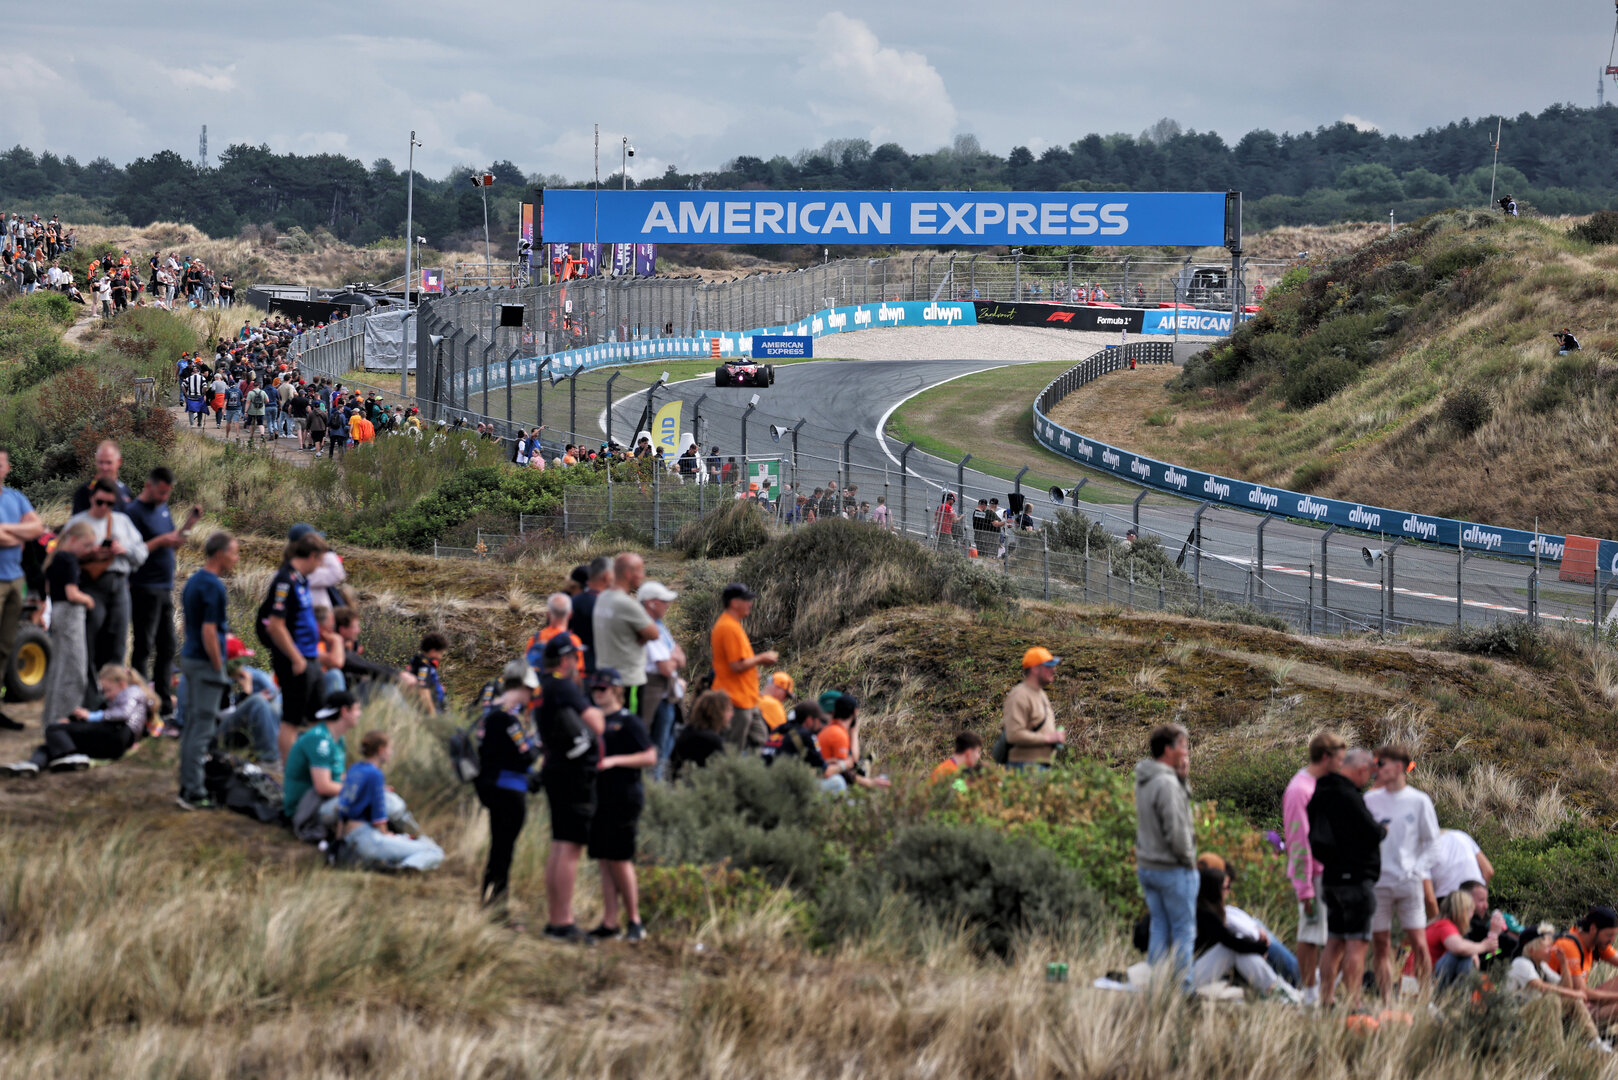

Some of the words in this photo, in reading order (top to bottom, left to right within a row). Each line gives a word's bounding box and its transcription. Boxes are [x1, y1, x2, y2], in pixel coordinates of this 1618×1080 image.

[641, 202, 891, 234] AMERICAN
[910, 203, 1129, 235] EXPRESS
[923, 302, 961, 326] allwyn
[1097, 316, 1123, 325] Formula
[1158, 315, 1231, 332] AMERICAN
[761, 341, 804, 349] AMERICAN
[767, 348, 805, 356] EXPRESS
[661, 417, 675, 446] AID
[1164, 467, 1188, 491] allwyn
[1203, 476, 1230, 501] allwyn
[1248, 486, 1278, 511] allwyn
[1297, 496, 1328, 521] allwyn
[1348, 505, 1381, 530] allwyn
[1402, 515, 1437, 540] allwyn
[1463, 525, 1502, 550] allwyn
